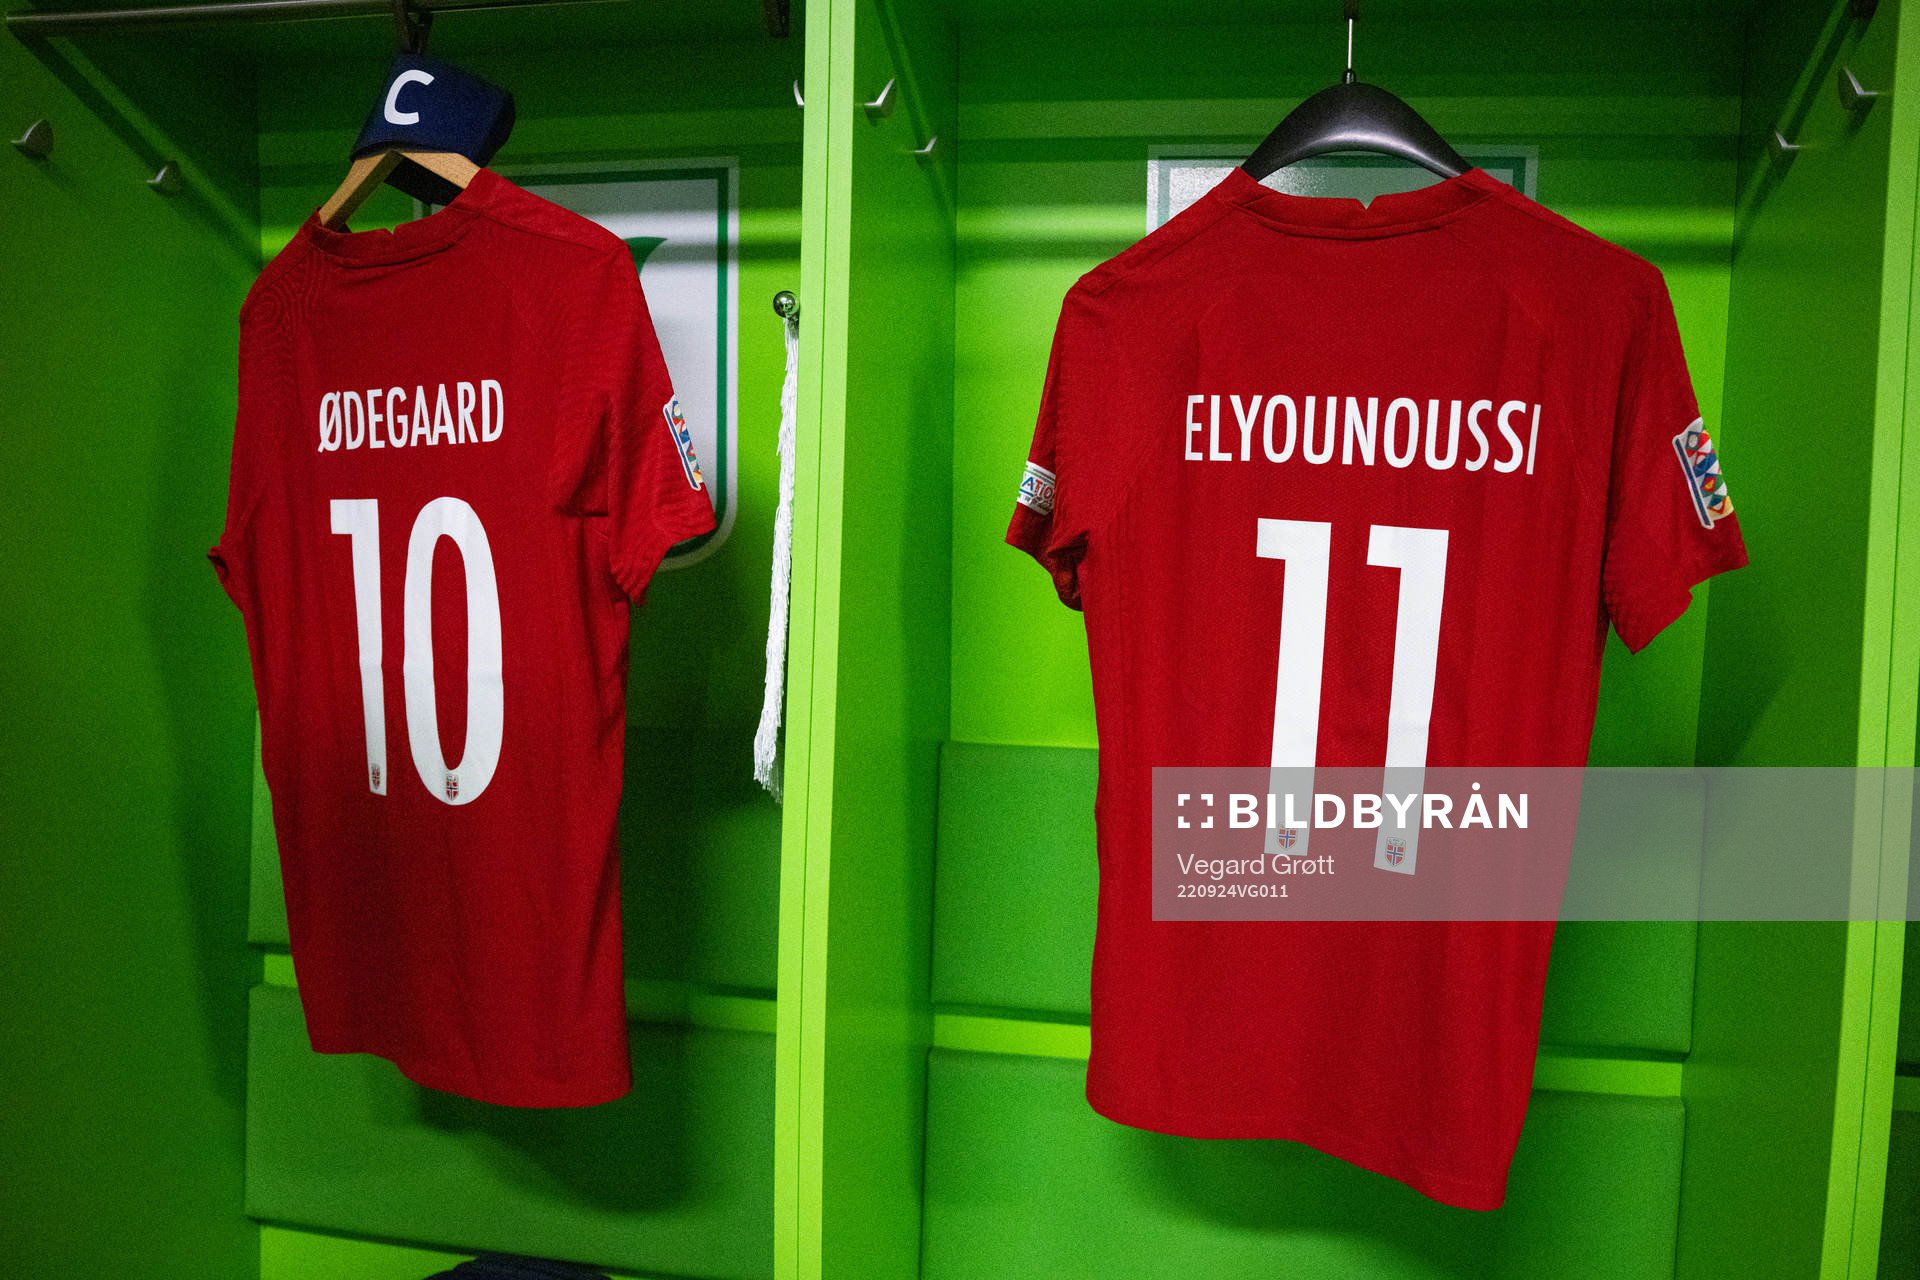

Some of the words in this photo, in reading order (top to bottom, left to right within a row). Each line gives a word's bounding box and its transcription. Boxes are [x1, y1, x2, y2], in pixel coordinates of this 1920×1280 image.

[384, 70, 434, 125] C
[318, 380, 504, 453] ØDEGAARD
[1184, 394, 1542, 475] ELYOUNOUSSI
[330, 496, 505, 806] 10
[1256, 518, 1450, 875] 11
